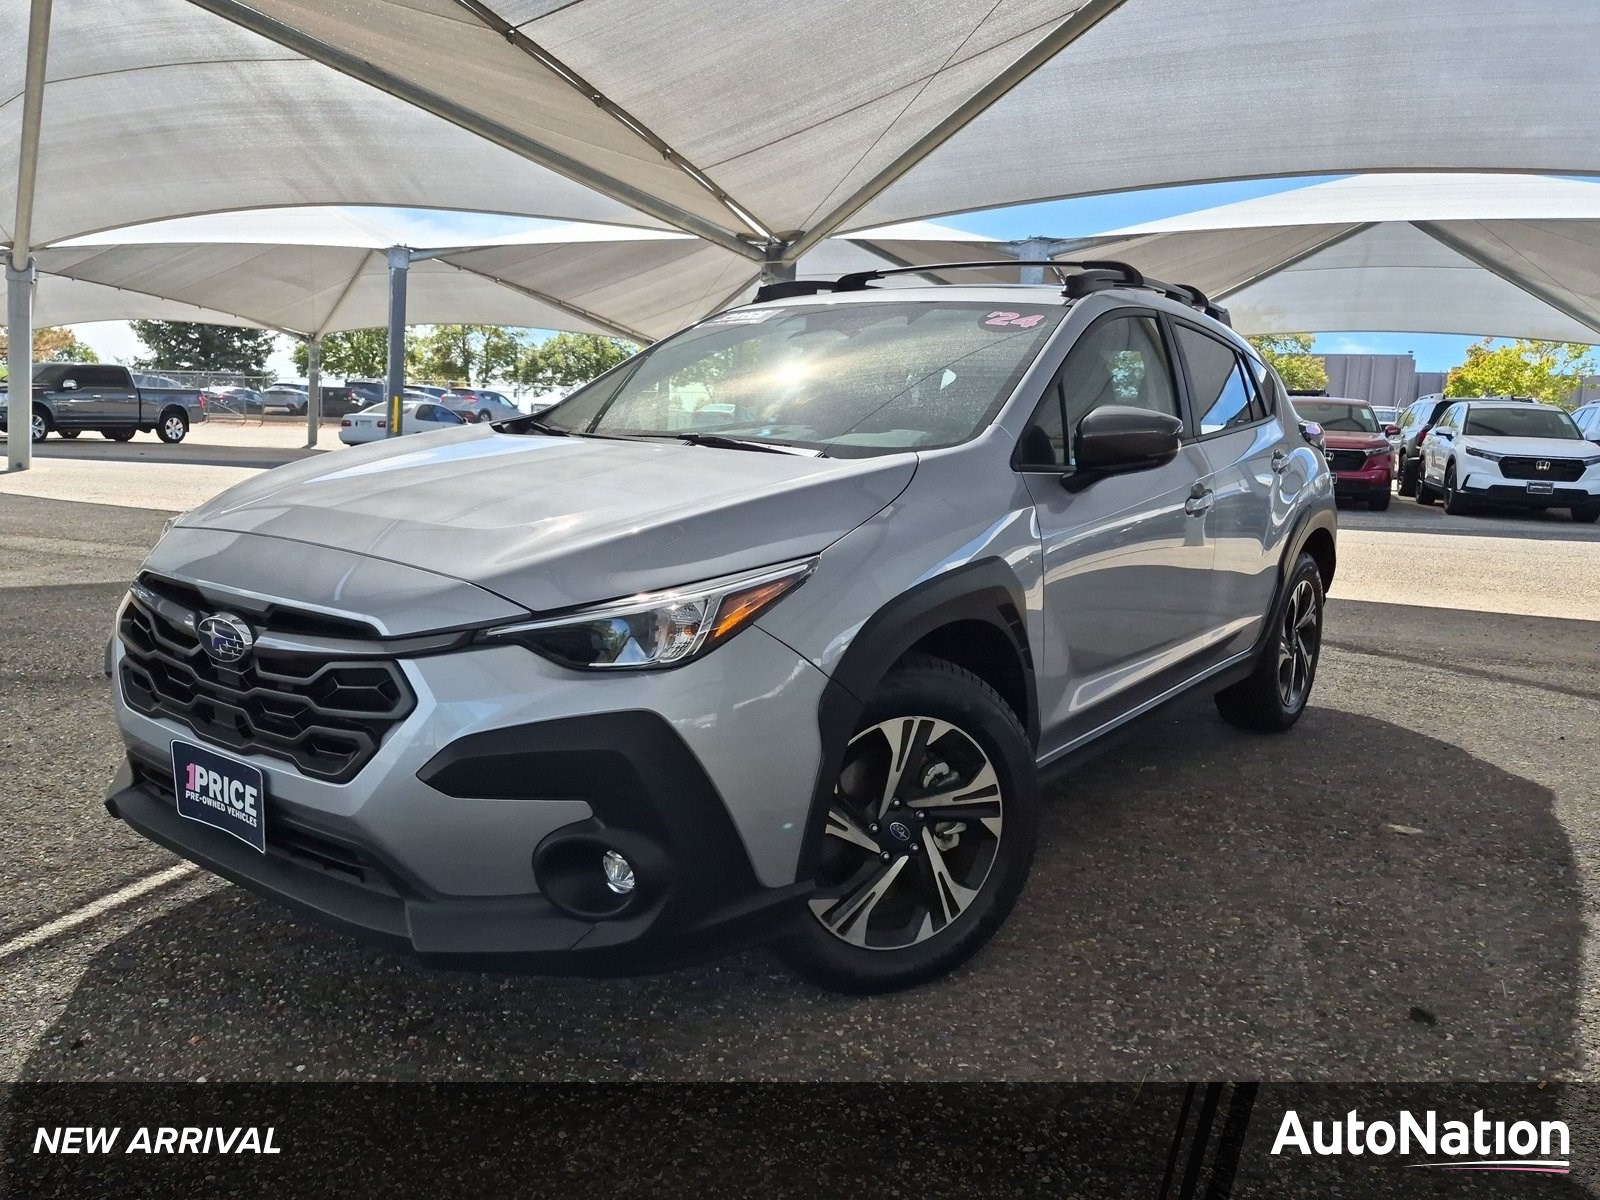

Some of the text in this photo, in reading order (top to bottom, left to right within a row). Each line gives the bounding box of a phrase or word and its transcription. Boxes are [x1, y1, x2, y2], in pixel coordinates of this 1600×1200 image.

[185, 763, 257, 817] 1PRICE
[185, 790, 257, 828] PRE-OWNED VEHICLES
